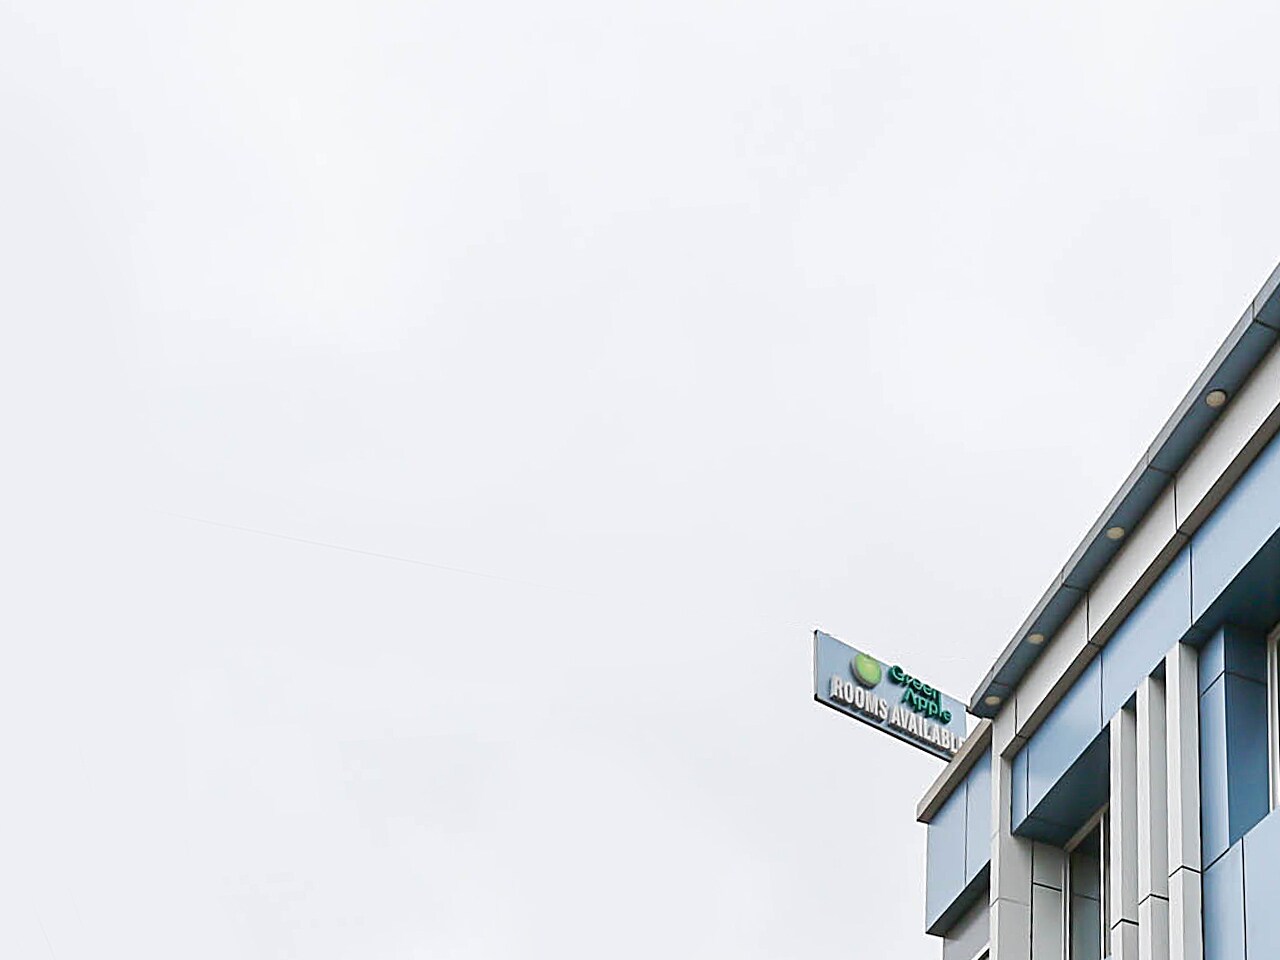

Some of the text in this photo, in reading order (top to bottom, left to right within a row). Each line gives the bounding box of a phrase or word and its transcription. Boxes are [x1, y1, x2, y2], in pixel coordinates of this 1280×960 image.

[829, 675, 888, 722] ROOMS
[888, 664, 943, 699] Green
[902, 688, 952, 725] Apple
